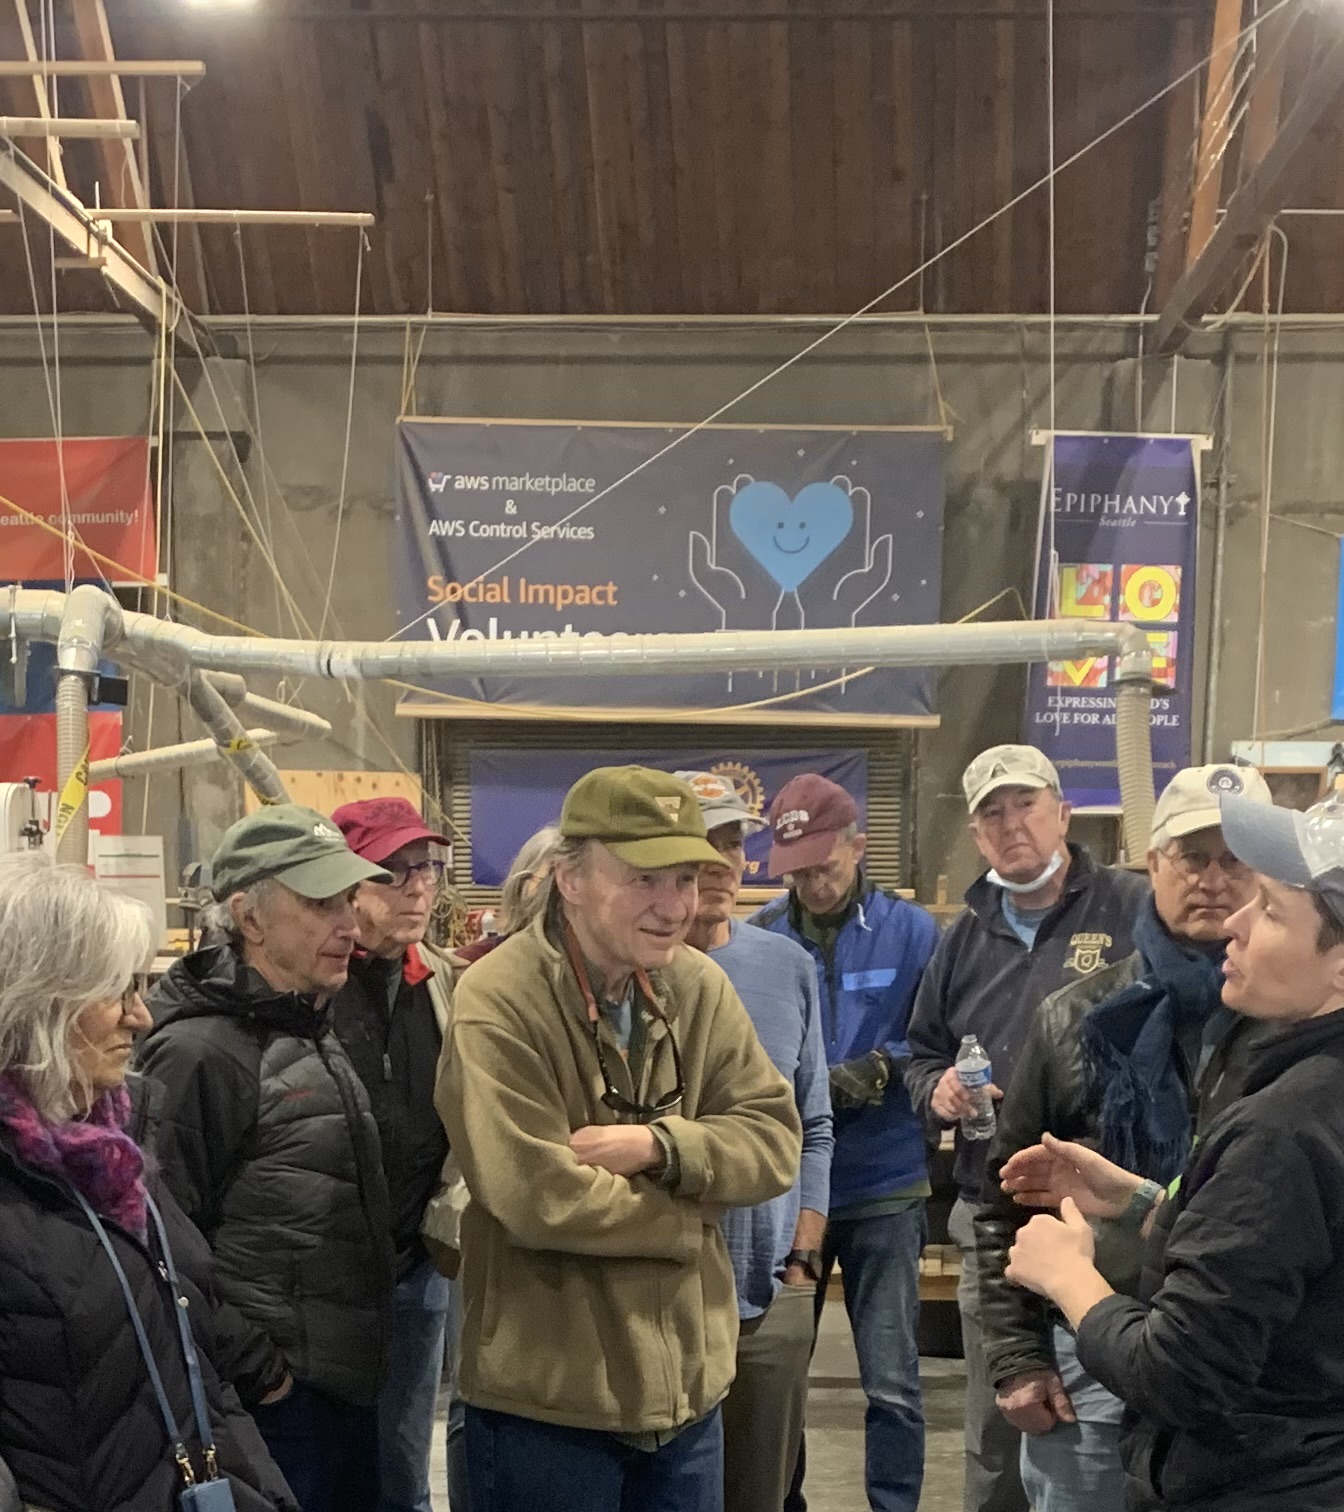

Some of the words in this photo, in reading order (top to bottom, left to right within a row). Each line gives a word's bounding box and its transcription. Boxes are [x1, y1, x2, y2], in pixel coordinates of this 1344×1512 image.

[454, 474, 489, 490] aws
[492, 472, 596, 496] marketplace
[505, 500, 517, 514] &
[1050, 488, 1174, 516] EPIPHANY
[48, 509, 139, 527] community!
[1099, 516, 1137, 528] Seattle
[429, 520, 465, 537] AWS
[469, 520, 527, 538] Control
[531, 522, 596, 540] Services
[427, 576, 510, 603] Social
[519, 577, 618, 612] Impact
[1047, 696, 1117, 709] EXPRESSIN
[1150, 698, 1170, 710] D'S
[1035, 712, 1070, 724] LOVE
[1073, 713, 1100, 725] FOR
[1102, 714, 1116, 725] AL
[1150, 714, 1180, 727] OPLE
[1070, 932, 1112, 948] QUEEN'S
